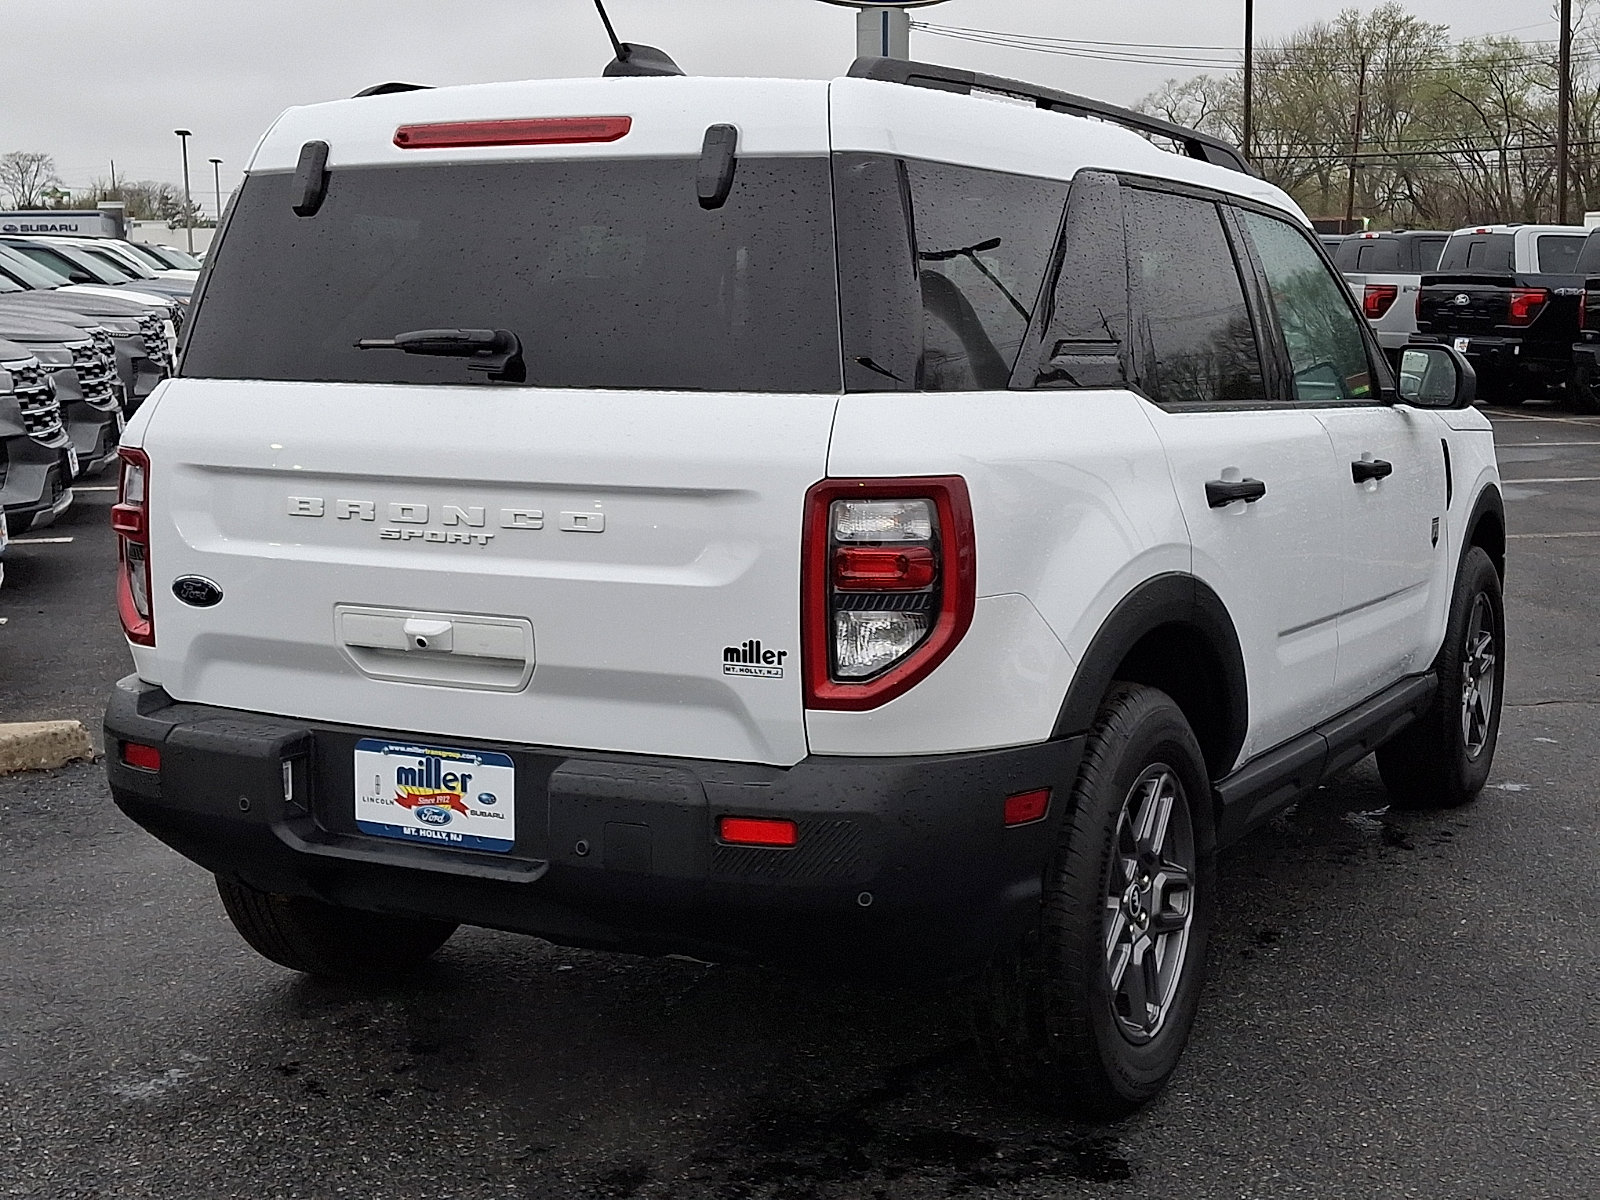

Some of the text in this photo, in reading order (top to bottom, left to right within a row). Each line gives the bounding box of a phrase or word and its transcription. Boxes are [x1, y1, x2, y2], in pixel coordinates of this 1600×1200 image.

[20, 224, 78, 232] SUBARU
[287, 496, 605, 533] BRONCO
[379, 527, 495, 545] SPORT
[723, 639, 787, 665] miller
[739, 667, 766, 675] HOLLY,
[396, 756, 473, 793] miller
[362, 796, 395, 806] LINCOLN
[436, 796, 450, 804] 1912
[421, 808, 446, 823] Ford
[470, 809, 504, 820] SUBARU
[403, 826, 463, 842] MT. HOLLY, NJ
